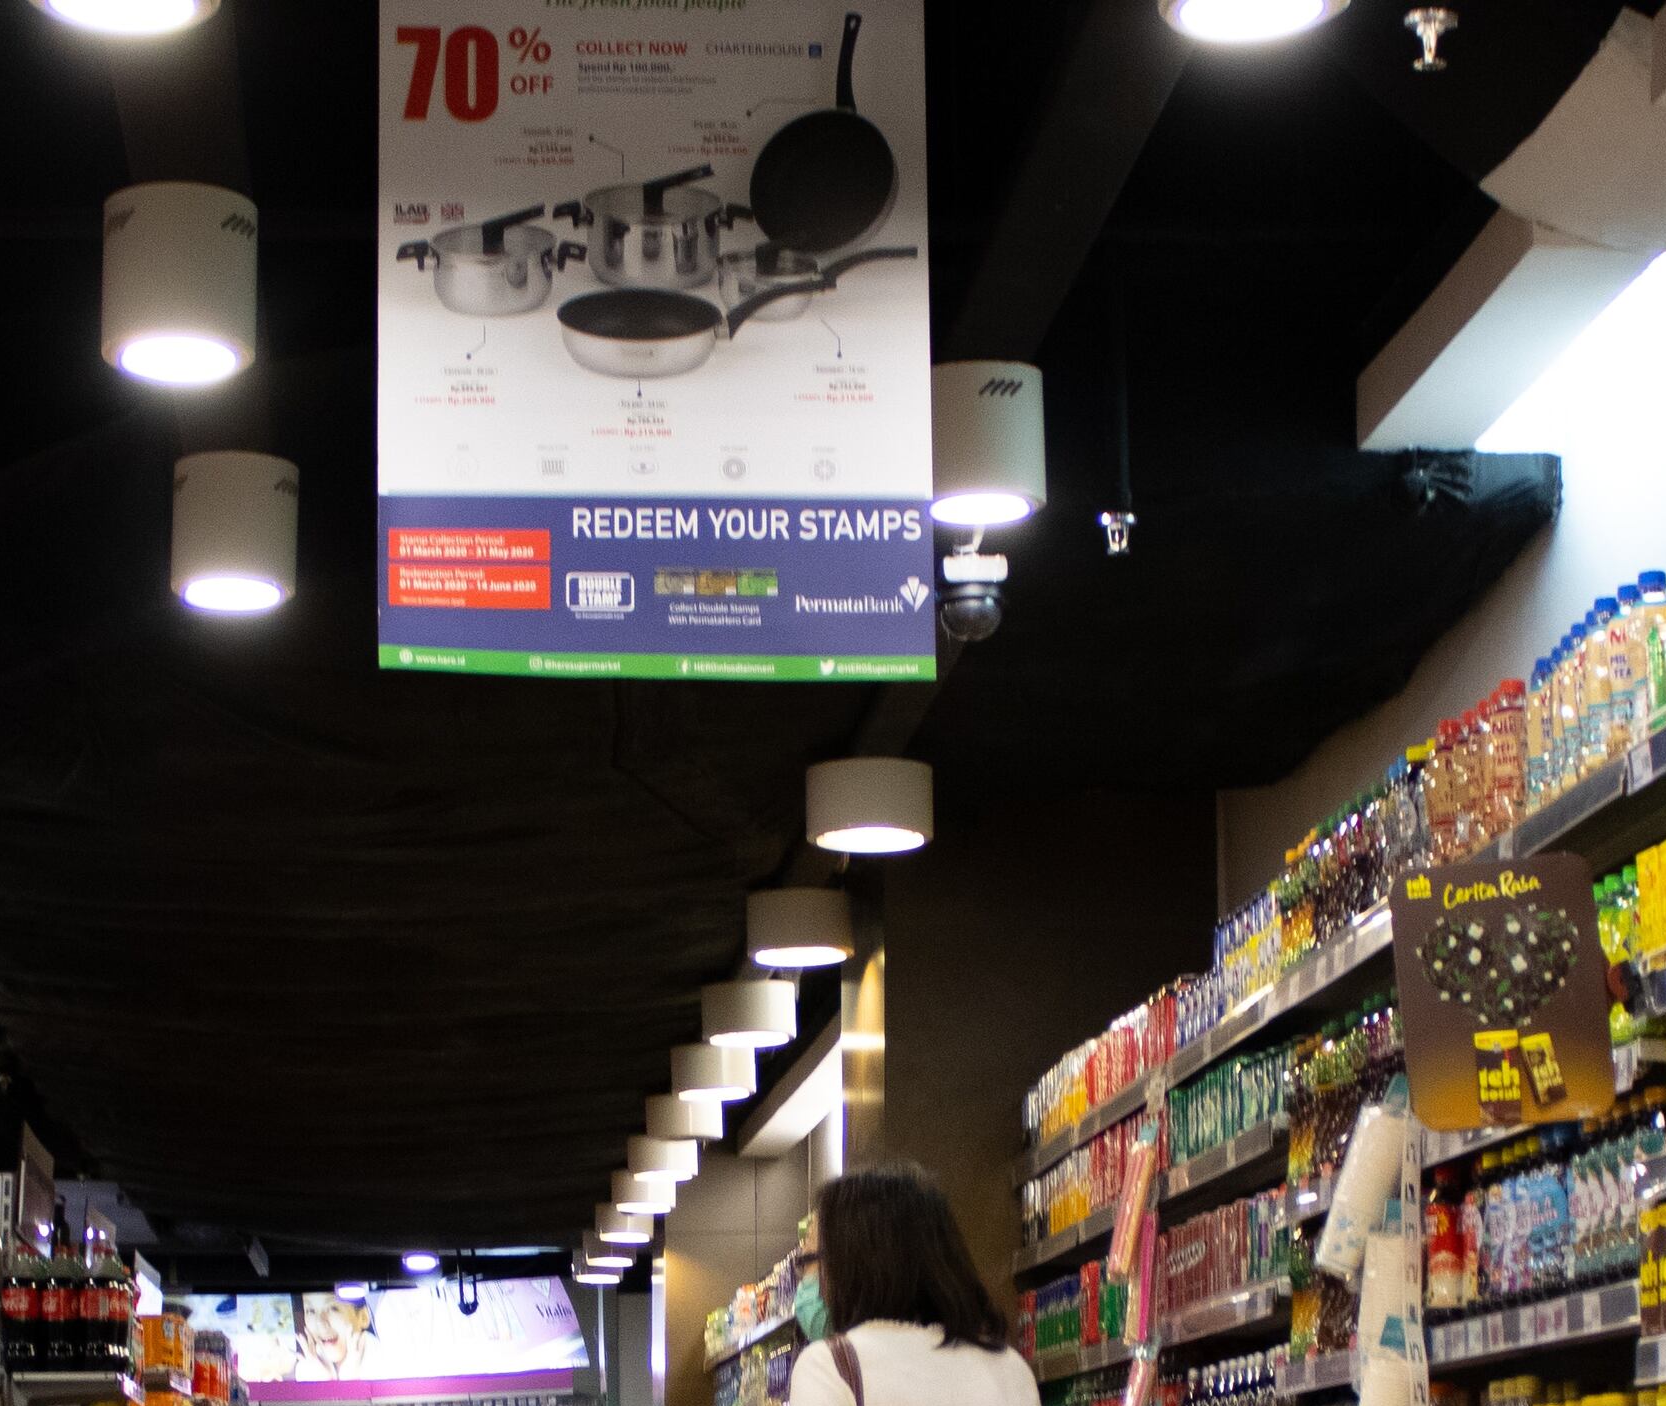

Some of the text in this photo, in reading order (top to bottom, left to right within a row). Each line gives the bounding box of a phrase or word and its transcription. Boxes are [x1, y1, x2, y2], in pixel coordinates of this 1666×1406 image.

[575, 41, 688, 56] COLLECT NOW
[510, 75, 554, 96] OFF
[572, 507, 922, 542] REDEEM YOUR STAMPS
[578, 592, 622, 608] STAMP
[795, 594, 904, 614] PermataBank
